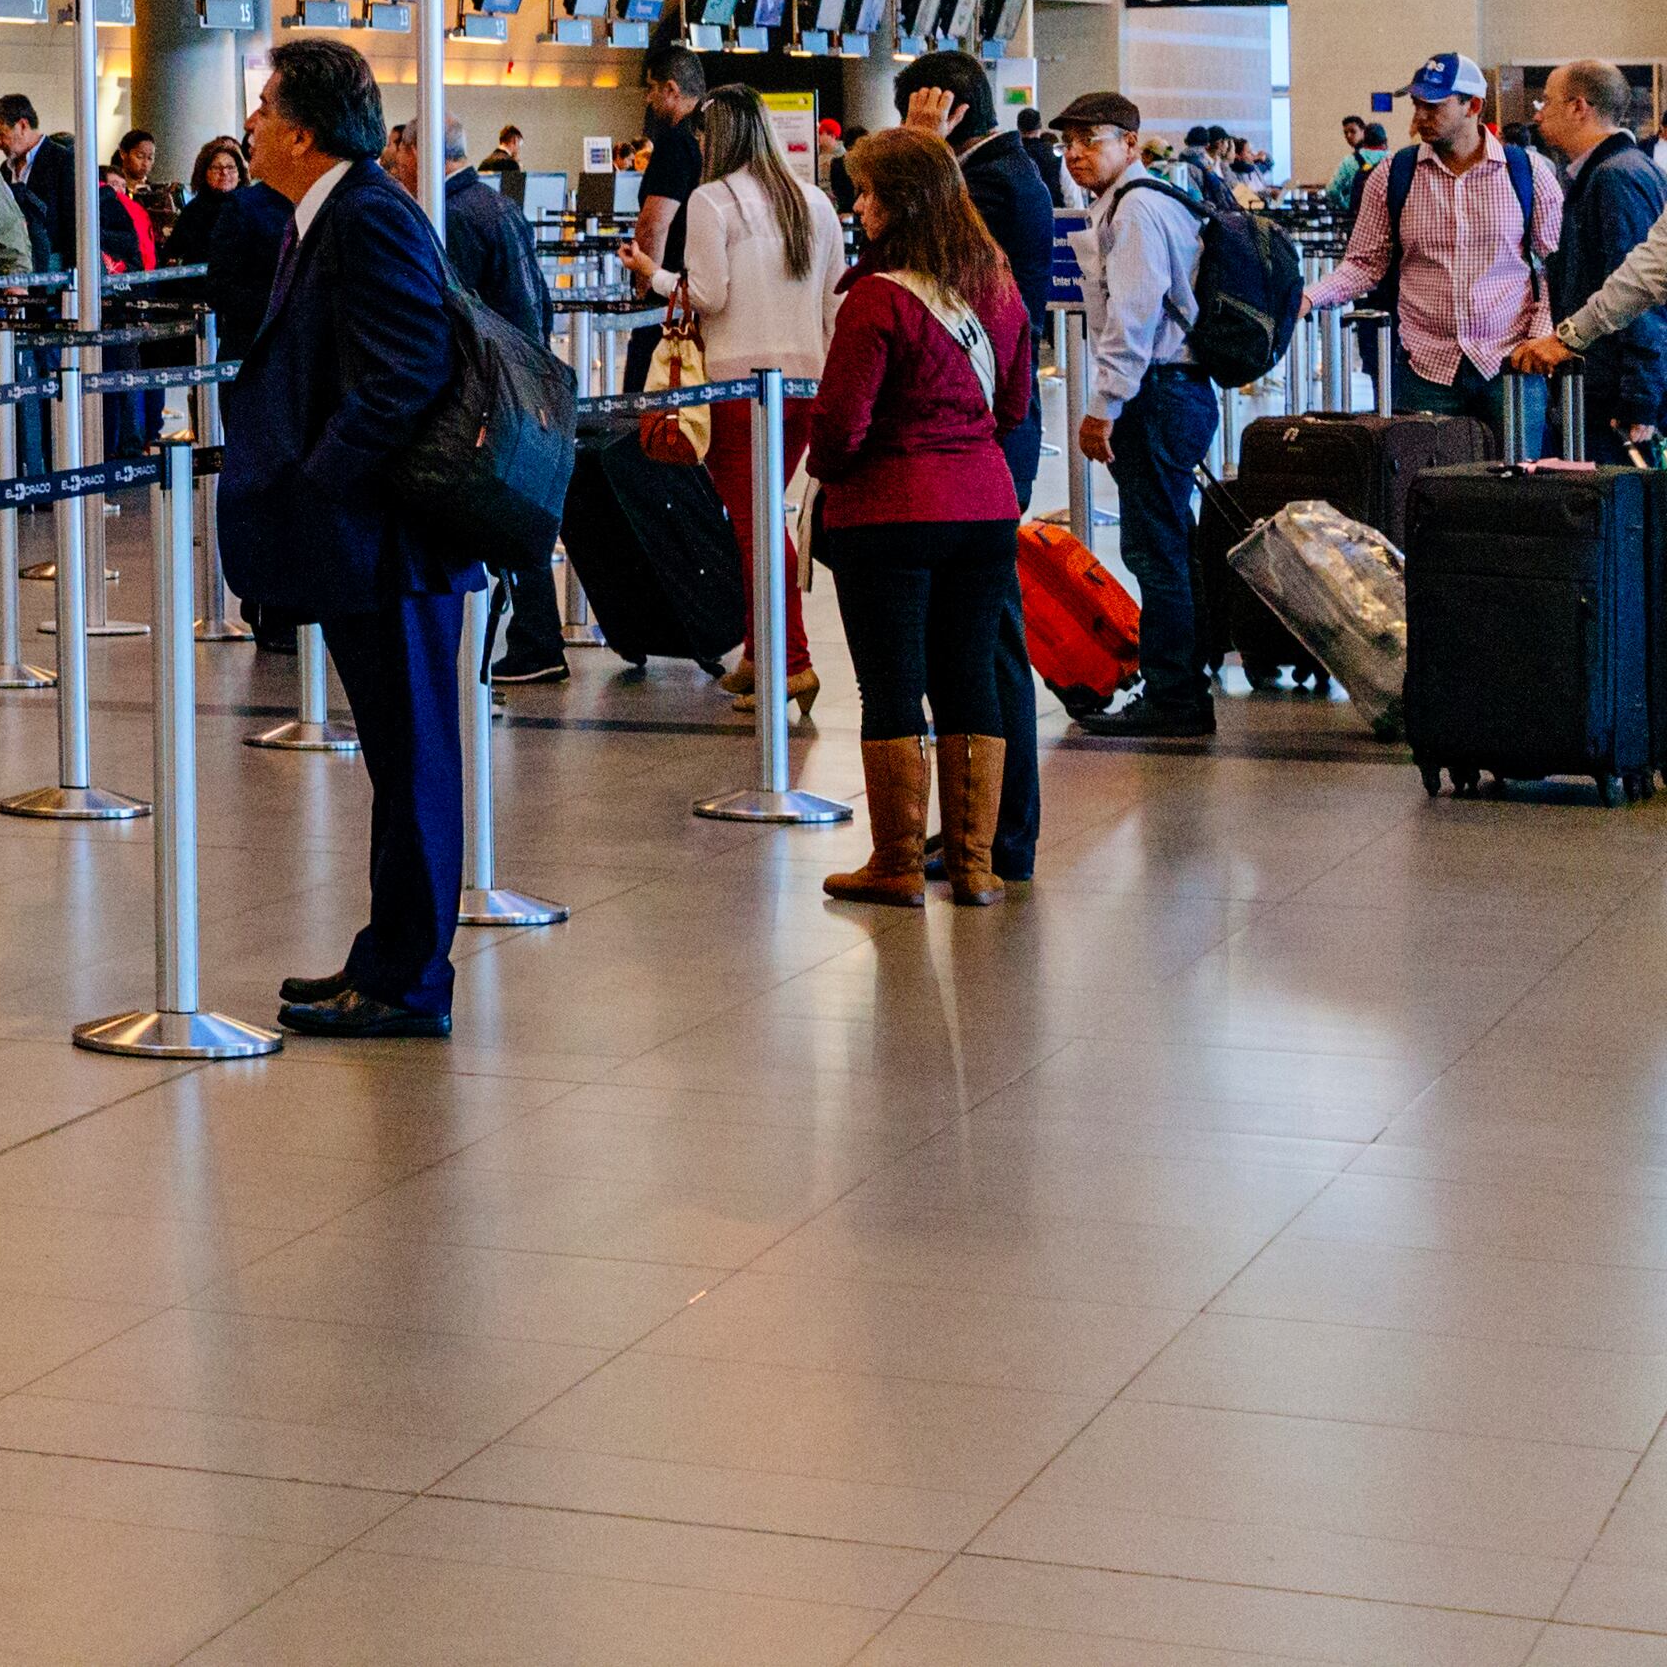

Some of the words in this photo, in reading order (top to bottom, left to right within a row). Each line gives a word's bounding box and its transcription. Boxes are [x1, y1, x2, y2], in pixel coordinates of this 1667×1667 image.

[240, 2, 252, 24] 15
[337, 2, 348, 23] 14
[399, 8, 410, 27] 13
[496, 19, 506, 38] 12
